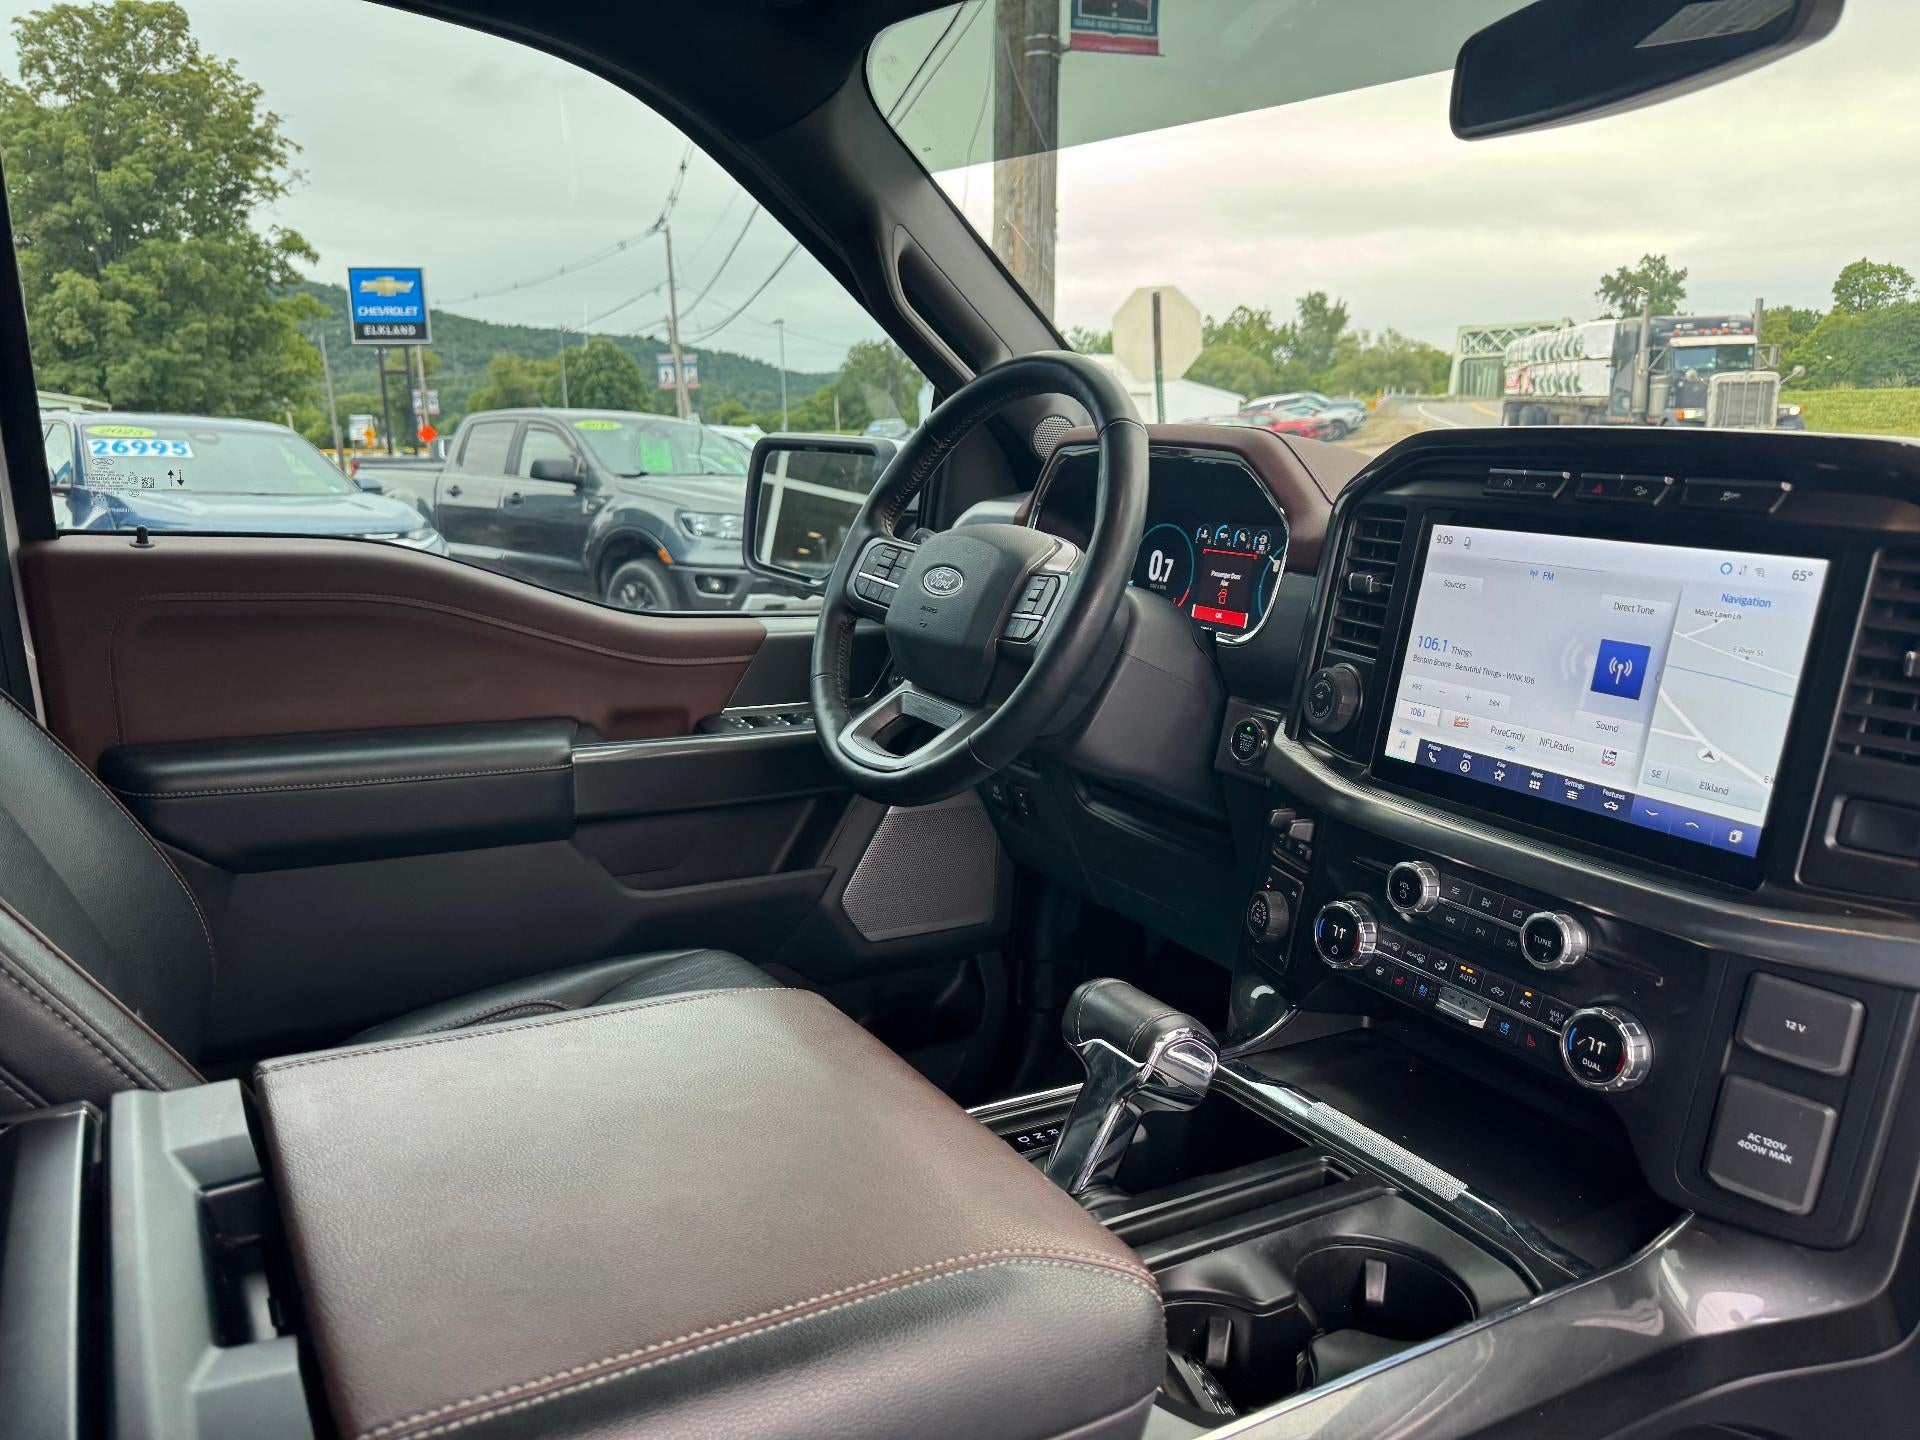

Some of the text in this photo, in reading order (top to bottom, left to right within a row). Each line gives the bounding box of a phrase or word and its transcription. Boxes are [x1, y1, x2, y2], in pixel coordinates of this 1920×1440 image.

[357, 305, 419, 317] CHEVROLET
[363, 324, 416, 336] ELKLAND
[91, 440, 188, 456] 26995
[1436, 534, 1454, 545] 9:09
[1148, 549, 1175, 583] 0.7
[1210, 569, 1231, 579] Passenger
[1542, 571, 1555, 581] FM
[1791, 569, 1814, 582] 65°
[1220, 579, 1229, 587] Ajar
[1443, 579, 1467, 590] Sources
[1721, 593, 1772, 609] Navigation
[1613, 601, 1655, 616] Direct Tune
[1694, 608, 1742, 621] Maple Lawn Ln
[1418, 635, 1473, 658] 106.1 Things
[1738, 646, 1755, 656] River
[1412, 654, 1433, 665] Benson
[1433, 658, 1452, 669] Boone
[1454, 662, 1482, 675] Beautiful
[1482, 667, 1502, 679] Things
[1523, 676, 1535, 684] 106
[1410, 707, 1426, 718] 106.1
[1595, 720, 1619, 733] Sound
[1490, 725, 1526, 742] PureCmdy
[1427, 743, 1442, 751] Phone
[1539, 737, 1575, 753] NFLRadio
[1530, 770, 1544, 779] Apps
[1651, 769, 1662, 779] SE
[1564, 778, 1585, 790] Settings
[1698, 781, 1729, 796] Elkland
[1602, 788, 1626, 801] Features
[1533, 934, 1553, 949] TUNE
[1459, 973, 1477, 985] AUTO
[1785, 1019, 1807, 1034] 12 V
[1582, 1057, 1602, 1072] DUAL
[1746, 1132, 1788, 1151] AC 120V
[1737, 1139, 1793, 1165] 400W MAX
